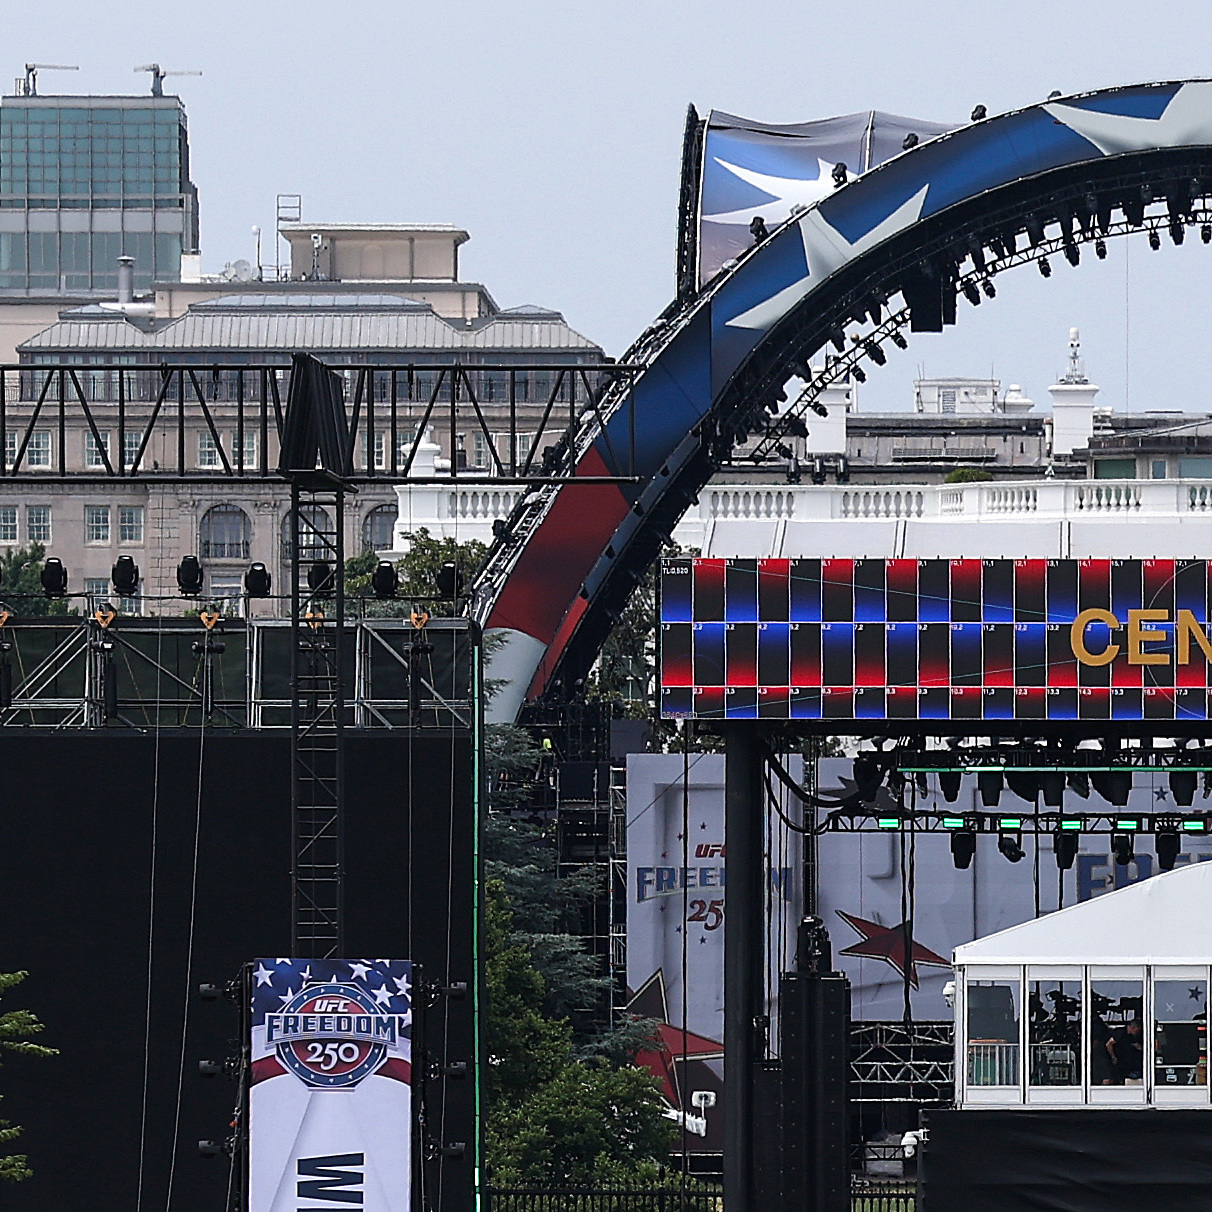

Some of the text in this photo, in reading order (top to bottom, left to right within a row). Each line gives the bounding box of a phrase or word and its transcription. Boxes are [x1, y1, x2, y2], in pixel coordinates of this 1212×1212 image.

[695, 844, 726, 858] UF
[637, 867, 793, 903] FREEM
[687, 899, 726, 931] 25
[313, 1000, 350, 1012] UFC
[267, 1015, 397, 1044] FREEDOM
[305, 1042, 360, 1070] 250
